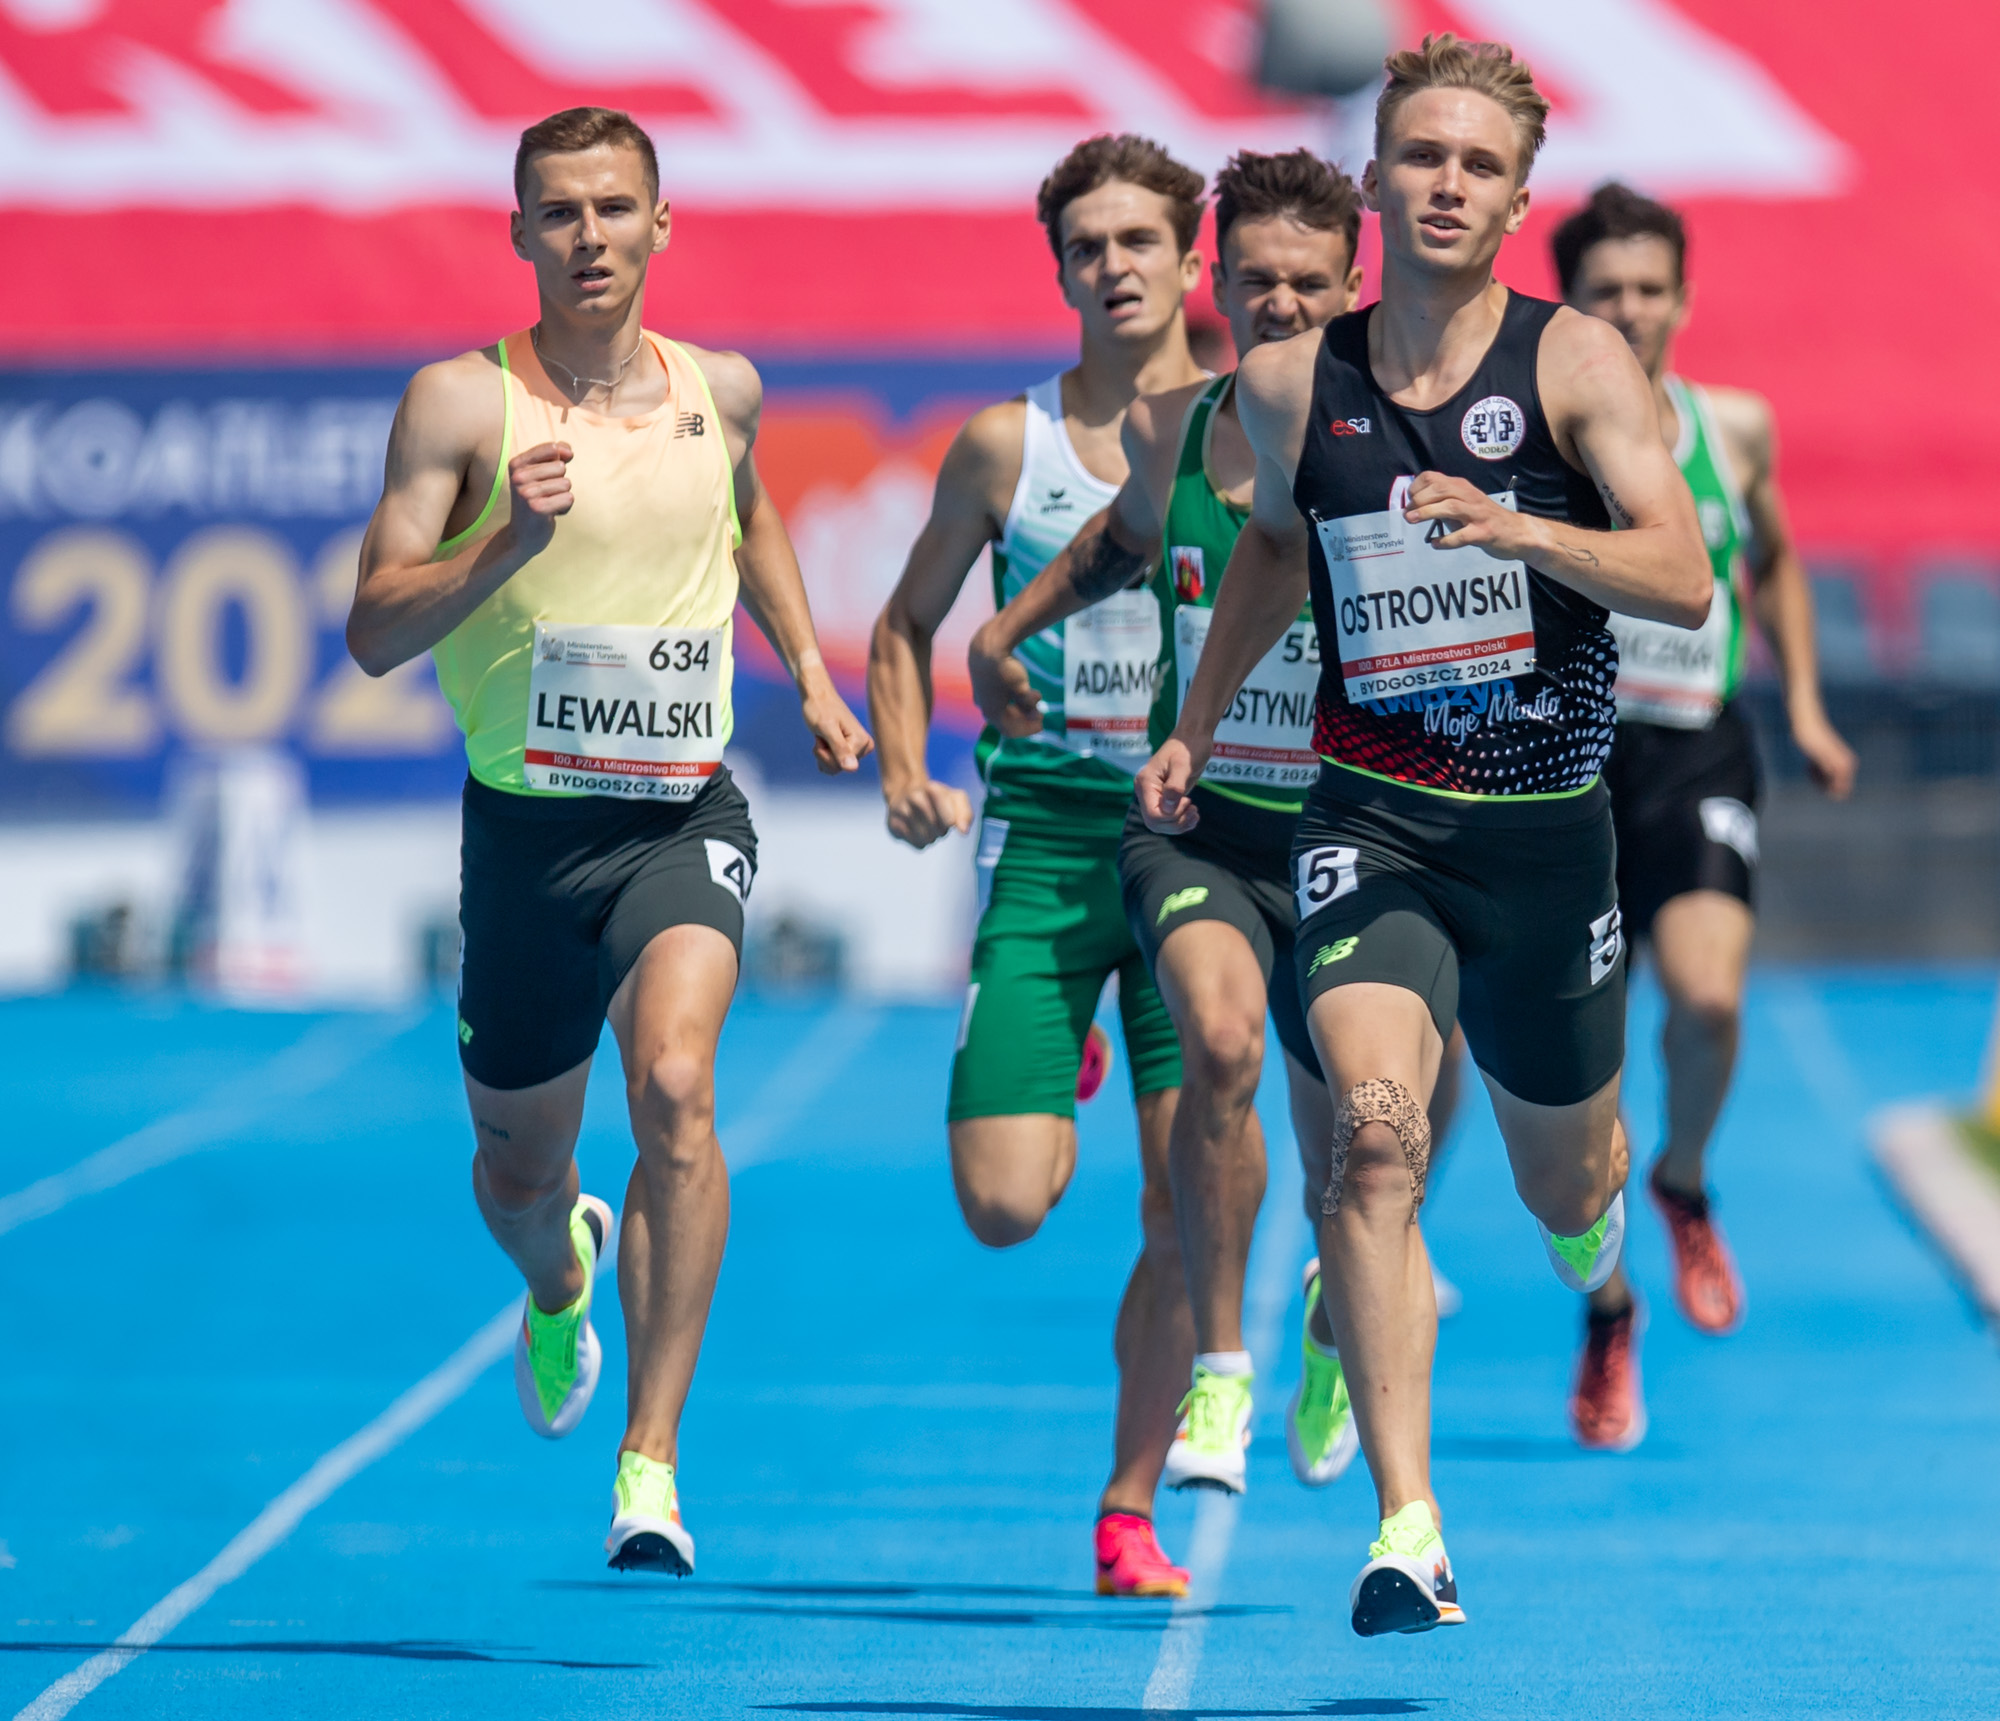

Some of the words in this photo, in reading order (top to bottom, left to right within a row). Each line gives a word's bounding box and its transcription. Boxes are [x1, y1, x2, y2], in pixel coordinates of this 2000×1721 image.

[1330, 417, 1372, 437] esa
[1478, 445, 1509, 454] RODŁO
[1343, 531, 1389, 543] Ministerstwo
[1345, 544, 1368, 554] Sportu
[1373, 539, 1404, 551] Turystyki
[1340, 571, 1523, 636] OSTROWSKI
[566, 650, 591, 660] Sportu
[596, 651, 628, 661] Turystyki
[567, 640, 614, 650] Ministerstwo
[649, 638, 710, 672] 634
[1375, 656, 1401, 670] PZLA
[1403, 647, 1472, 666] Mistrzostwa
[1473, 639, 1507, 655] Polski
[1359, 667, 1464, 695] BYDGOSZCZ
[1467, 658, 1512, 679] 2024
[536, 691, 713, 738] LEWALSKI
[1423, 699, 1481, 747] Moje
[575, 755, 601, 769] PZLA
[603, 760, 669, 775] Mistrzostwa
[669, 763, 700, 775] Polski
[548, 772, 657, 794] BYDGOSZCZ
[660, 783, 701, 796] 2024
[1306, 849, 1340, 903] 5
